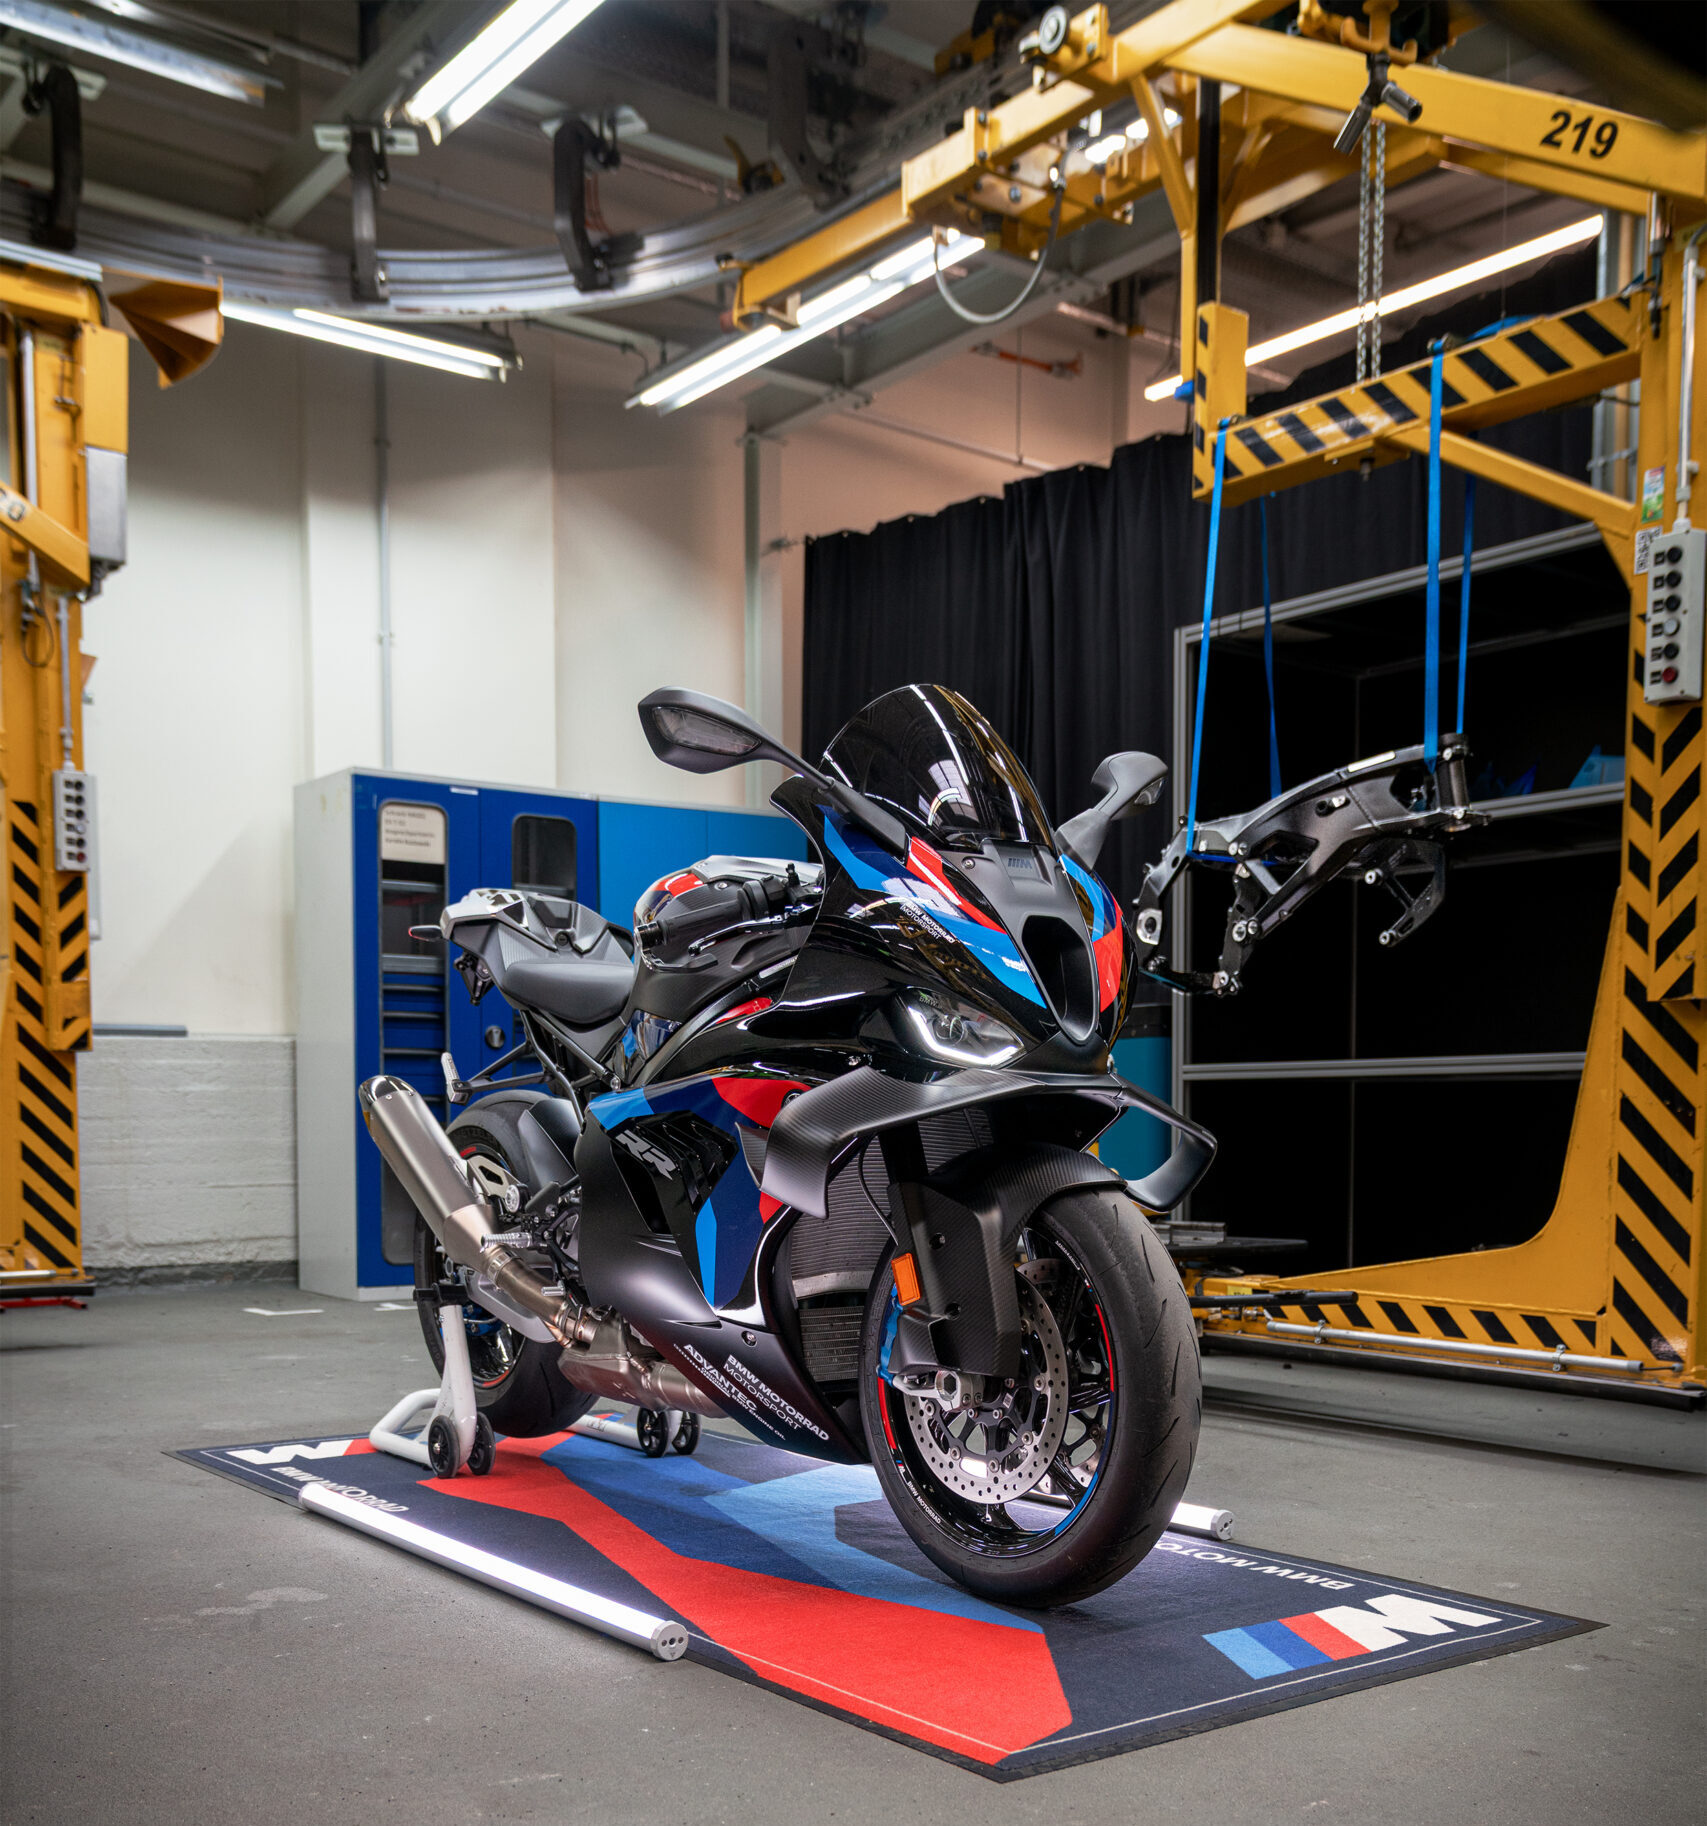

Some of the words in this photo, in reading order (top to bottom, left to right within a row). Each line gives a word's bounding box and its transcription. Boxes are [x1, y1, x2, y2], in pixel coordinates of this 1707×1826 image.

[1540, 110, 1619, 159] 219
[900, 903, 942, 940] MOTORSPORT
[921, 914, 956, 943] MOTORRAD
[615, 1129, 676, 1180] RR
[683, 1343, 758, 1411] ADVANTEC
[723, 1363, 802, 1430] MOTORSPORT
[727, 1354, 760, 1384] BMW
[759, 1382, 830, 1440] MOTORRAD
[748, 1409, 775, 1431] ENGINE
[270, 1466, 325, 1482] BMW
[916, 1496, 941, 1524] MOTORRAD
[1155, 1542, 1259, 1567] MOTO
[1248, 1566, 1356, 1590] BMW
